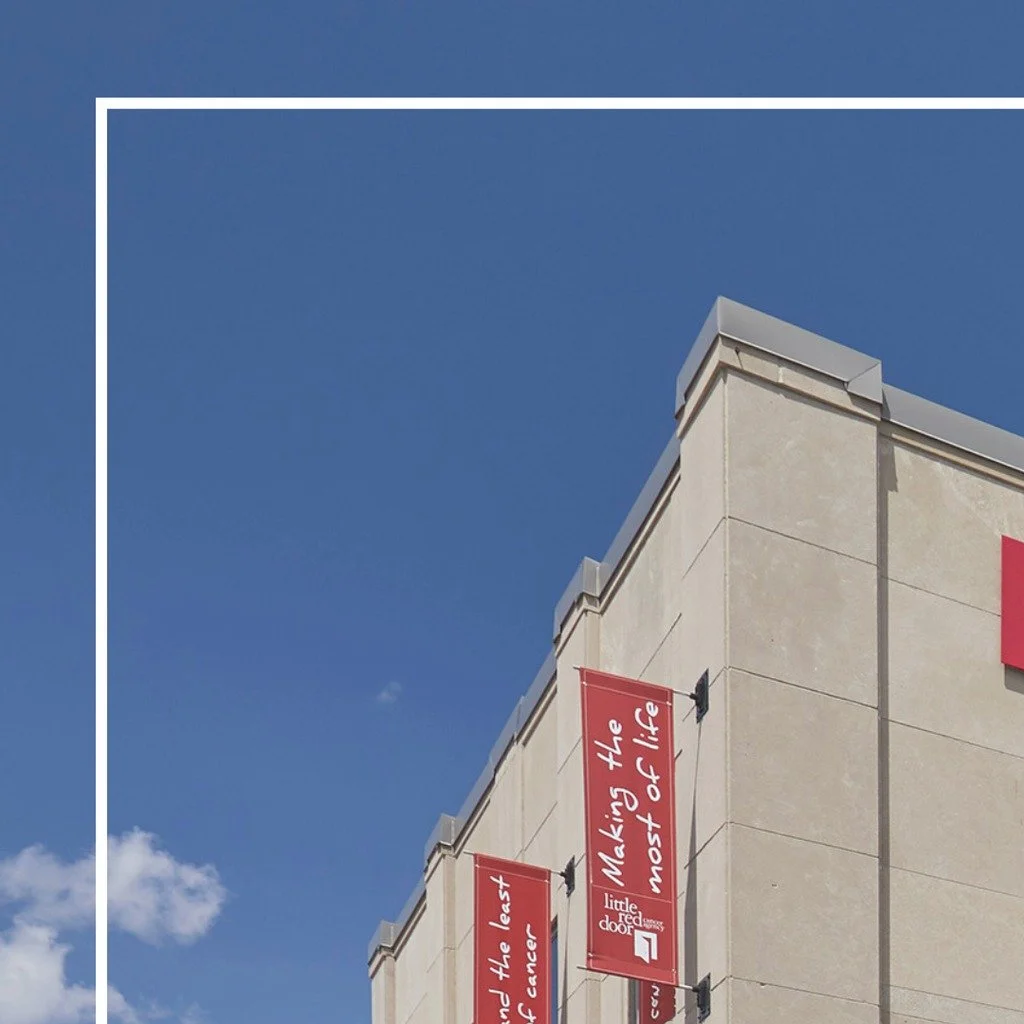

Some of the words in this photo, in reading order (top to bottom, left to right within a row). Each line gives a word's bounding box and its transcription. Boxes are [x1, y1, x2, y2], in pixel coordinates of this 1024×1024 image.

[594, 719, 623, 771] the
[633, 701, 659, 750] life
[636, 756, 661, 802] of
[597, 786, 638, 887] Making
[636, 812, 663, 894] most
[488, 875, 511, 931] least
[598, 914, 634, 936] door
[604, 892, 638, 915] little
[618, 910, 643, 928] red
[487, 941, 511, 981] the
[525, 923, 538, 999] cancer
